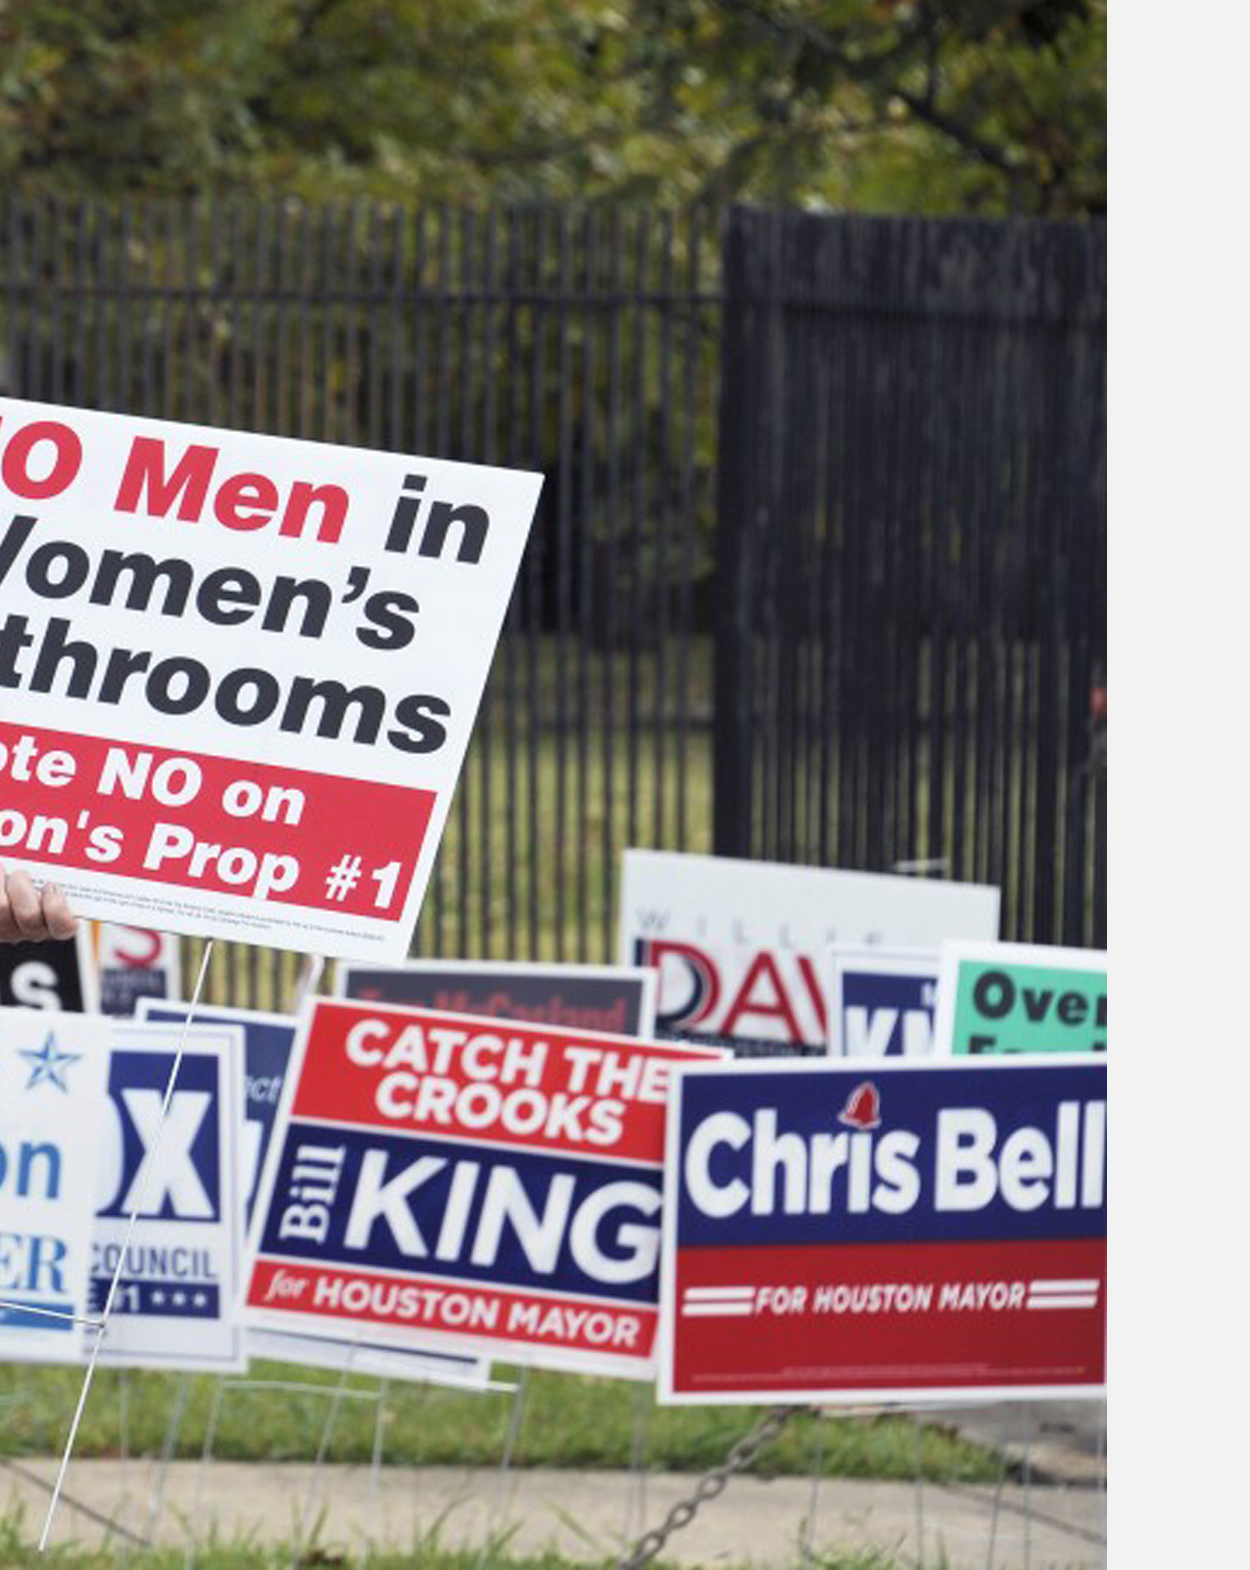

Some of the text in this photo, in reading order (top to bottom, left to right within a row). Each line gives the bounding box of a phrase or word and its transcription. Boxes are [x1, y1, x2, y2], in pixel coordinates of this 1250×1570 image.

[113, 435, 350, 544] Men
[384, 474, 491, 565] in
[97, 748, 202, 808] NO
[222, 781, 306, 825] on
[144, 821, 301, 902] Prop
[324, 854, 402, 909] #1
[345, 1019, 670, 1104] CATCH THE
[376, 1072, 625, 1146] CROOKS
[277, 1145, 347, 1245] Bill
[685, 1101, 1107, 1218] Chris Bell
[343, 1149, 665, 1285] KING
[265, 1270, 641, 1347] for HOUSTON MAYOR
[754, 1281, 1026, 1313] FOR HOUSTON MAYOR
